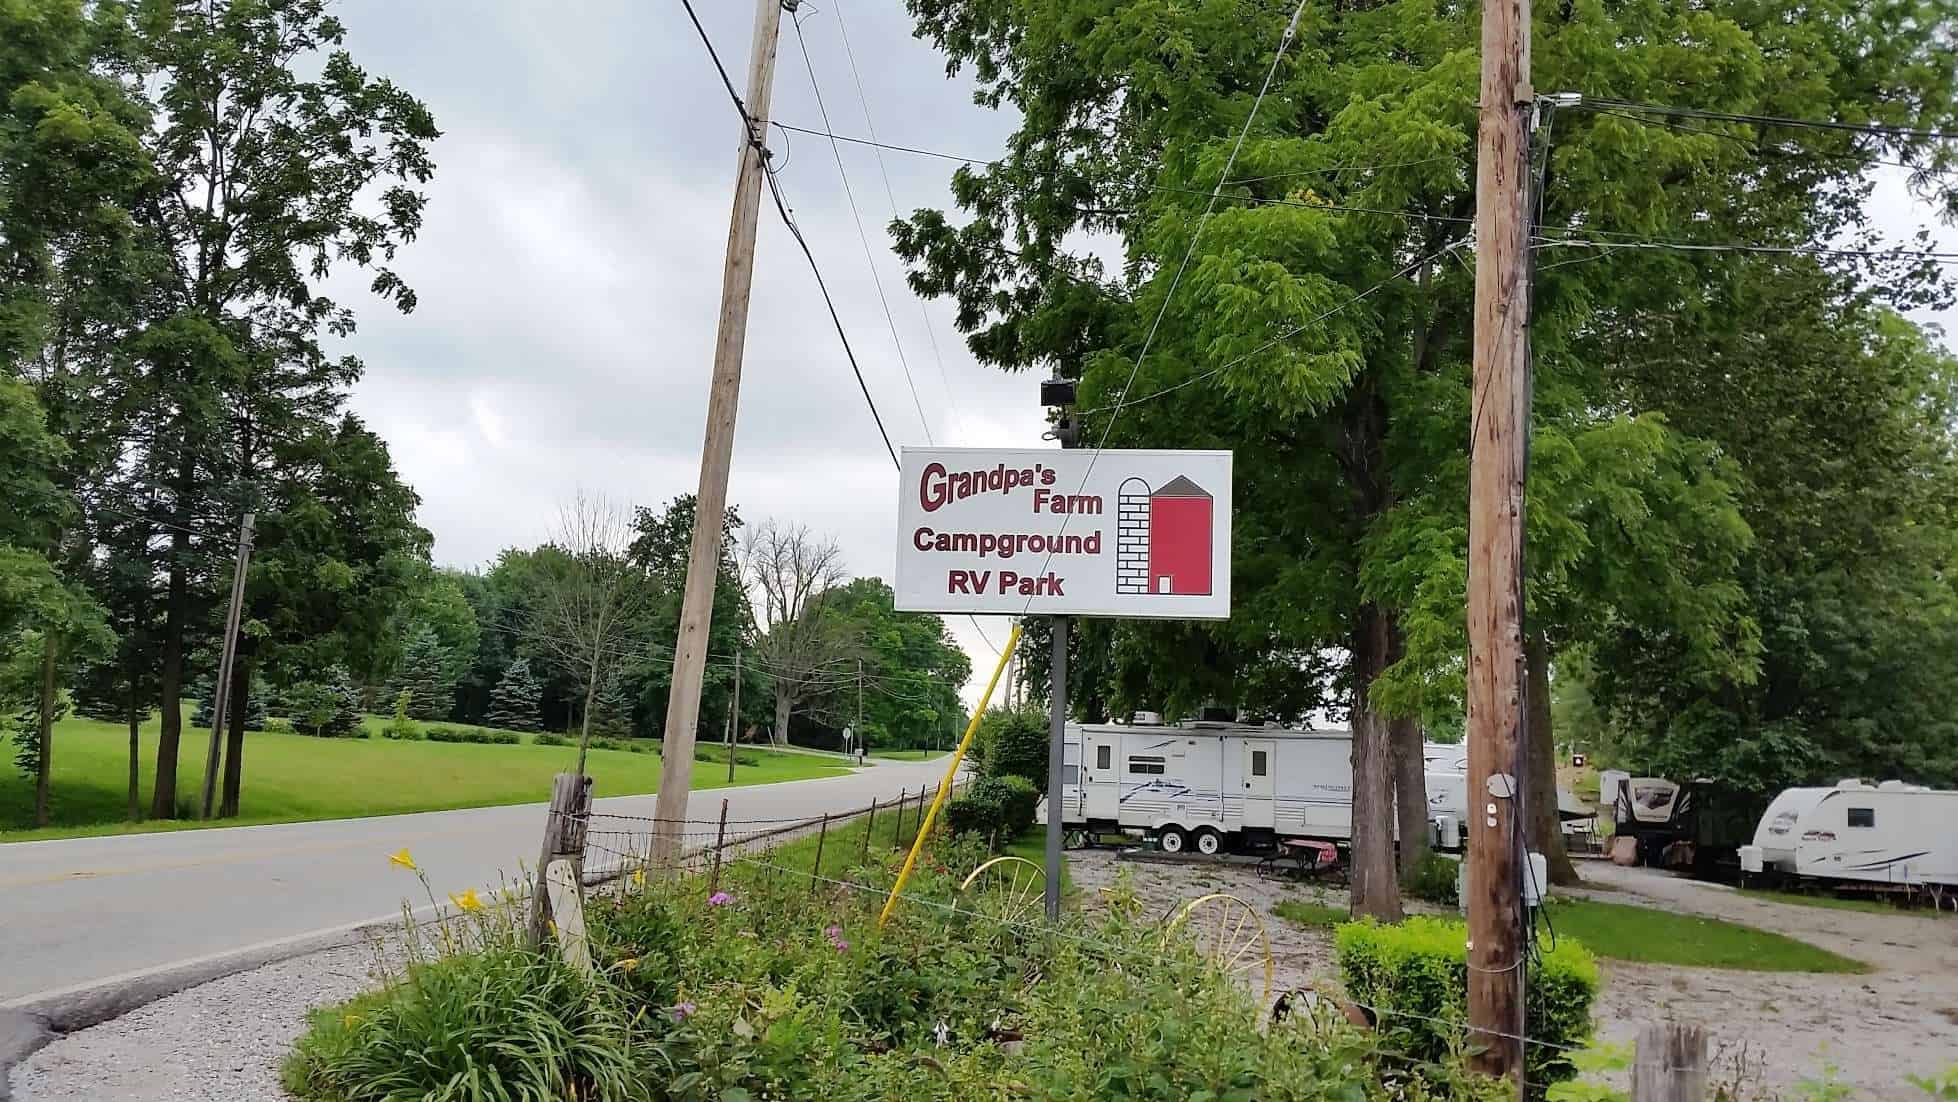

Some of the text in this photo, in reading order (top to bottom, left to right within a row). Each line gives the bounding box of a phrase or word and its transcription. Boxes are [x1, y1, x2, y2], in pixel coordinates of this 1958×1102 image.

[919, 462, 1056, 512] Grandpa's
[1033, 488, 1103, 514] Farm
[913, 526, 1101, 558] Campground
[948, 570, 1065, 596] RV Park
